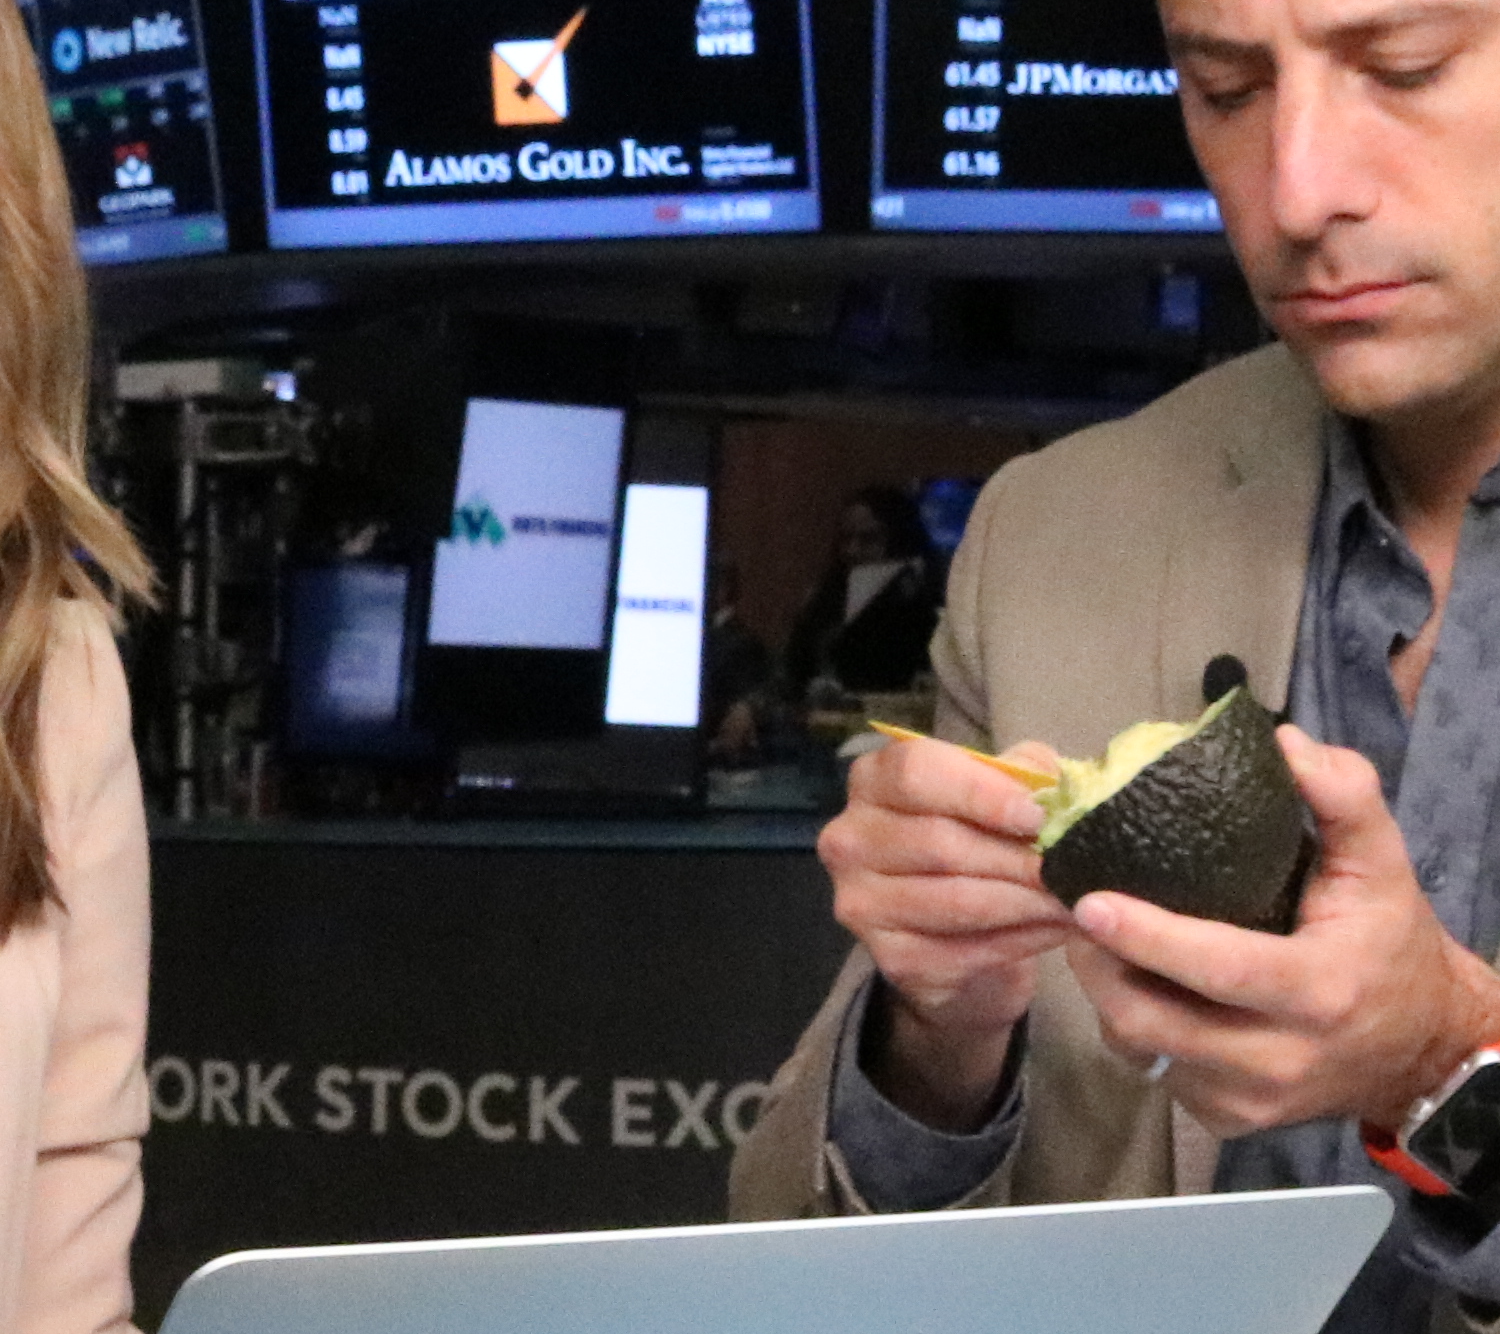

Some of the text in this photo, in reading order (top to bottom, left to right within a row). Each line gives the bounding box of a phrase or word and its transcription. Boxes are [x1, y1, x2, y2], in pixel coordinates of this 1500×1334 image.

[696, 28, 754, 56] NYSE
[384, 149, 513, 188] ALAMOS
[517, 141, 615, 181] GOLD
[620, 137, 690, 178] INC.
[314, 1065, 583, 1145] STOCK
